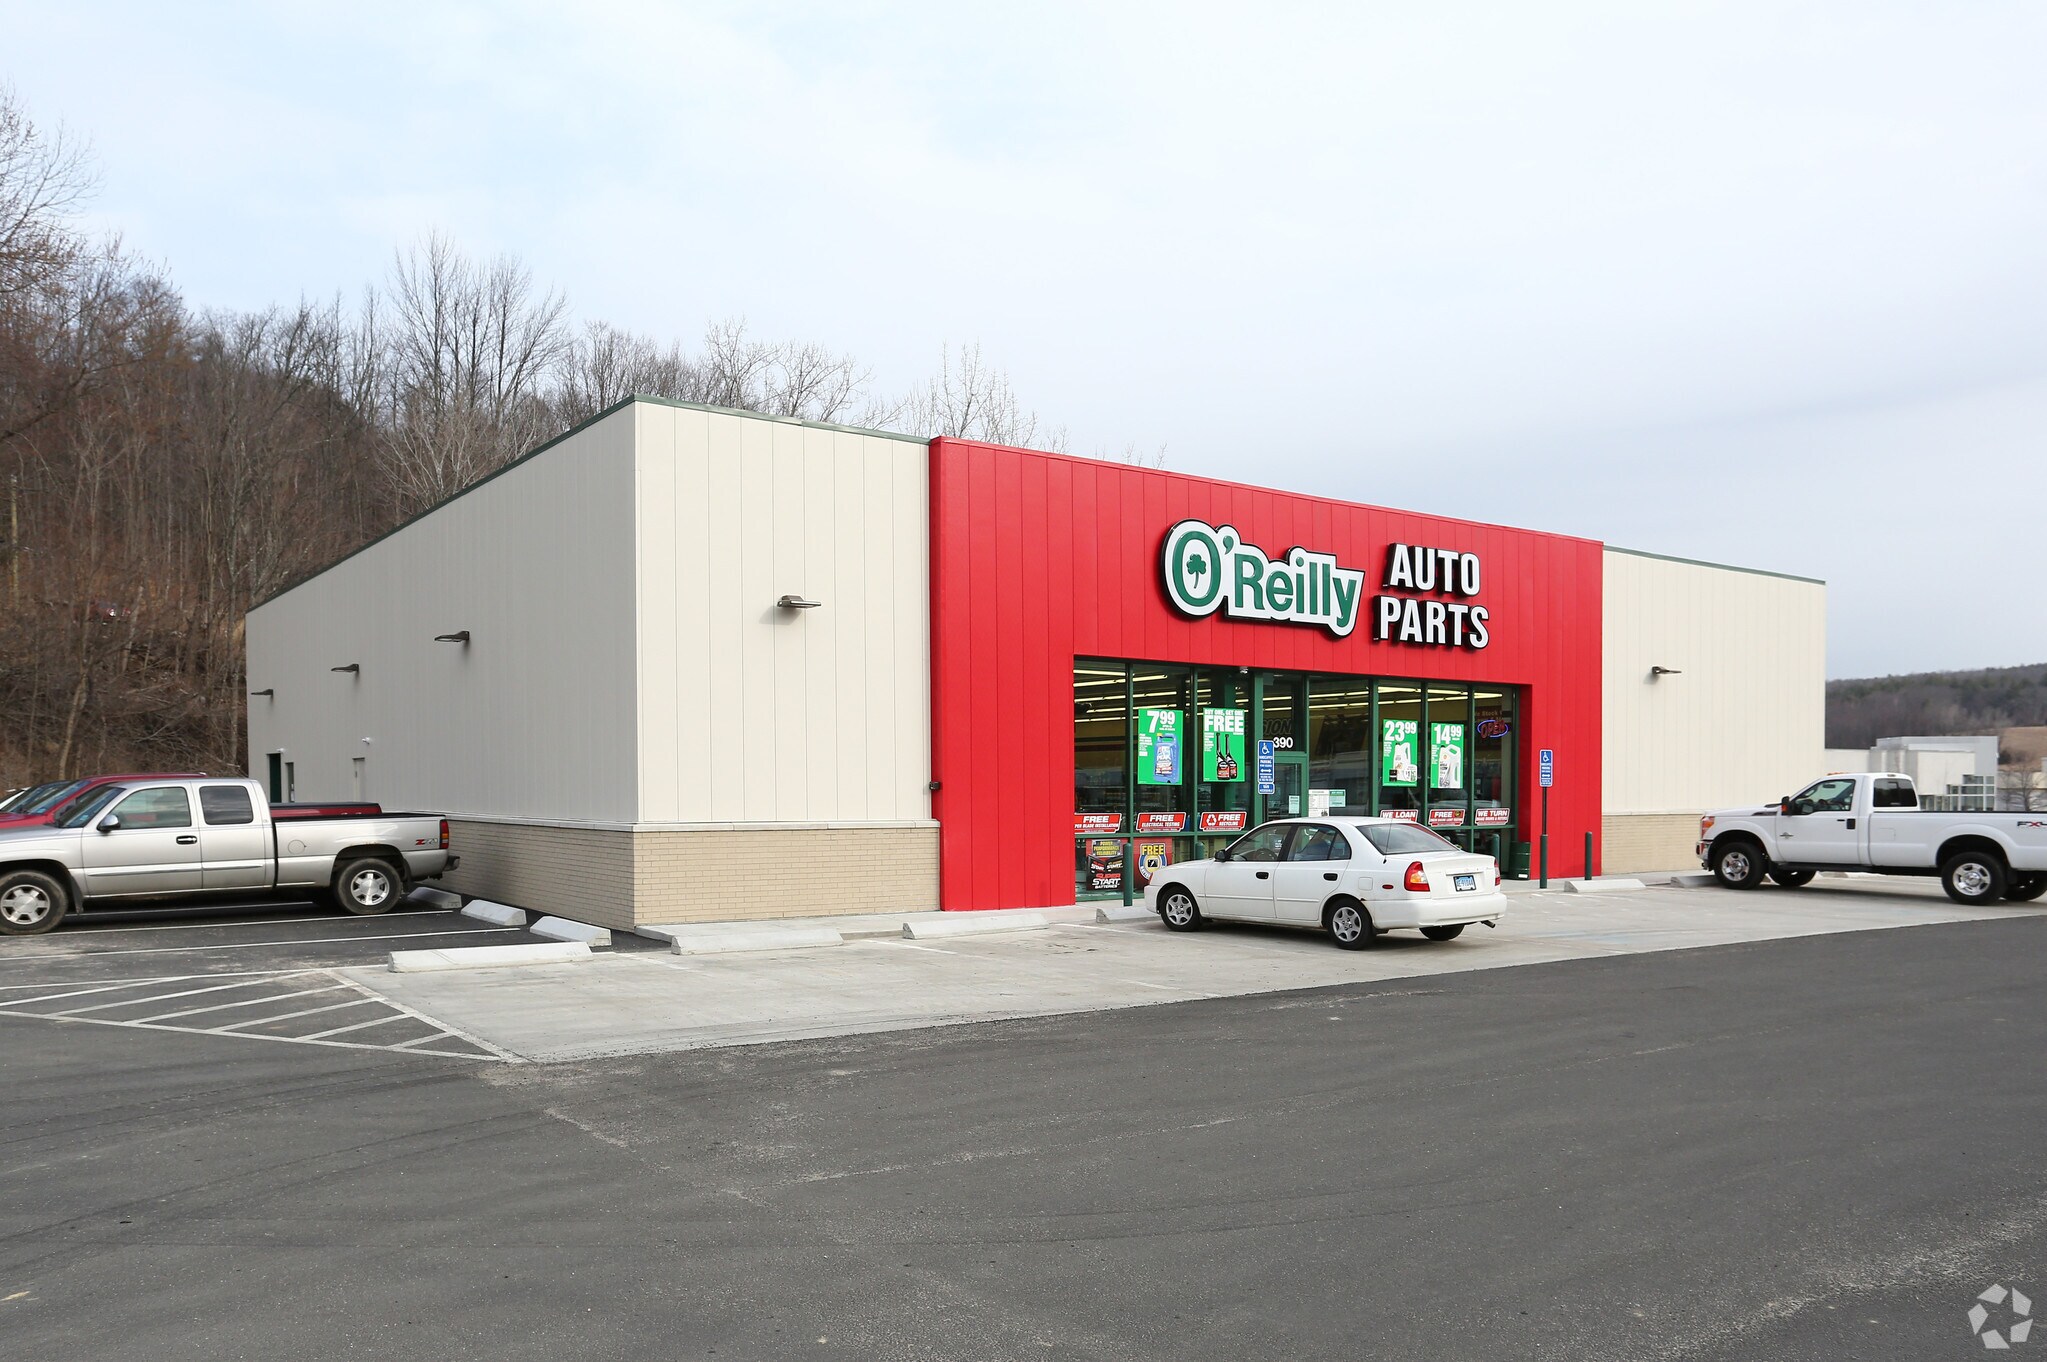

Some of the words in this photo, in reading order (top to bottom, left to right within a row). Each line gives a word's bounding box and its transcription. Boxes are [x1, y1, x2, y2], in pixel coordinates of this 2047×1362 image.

[1388, 543, 1481, 597] AUTO
[1171, 530, 1358, 628] O'Reilly
[1378, 595, 1490, 649] PARTS
[1204, 715, 1244, 732] FREE
[1273, 737, 1294, 748] 390
[1150, 814, 1175, 822] FREE
[1218, 813, 1241, 821] FREE
[1490, 809, 1508, 817] TURN
[1083, 815, 1110, 823] FREE
[1141, 845, 1164, 855] FREE
